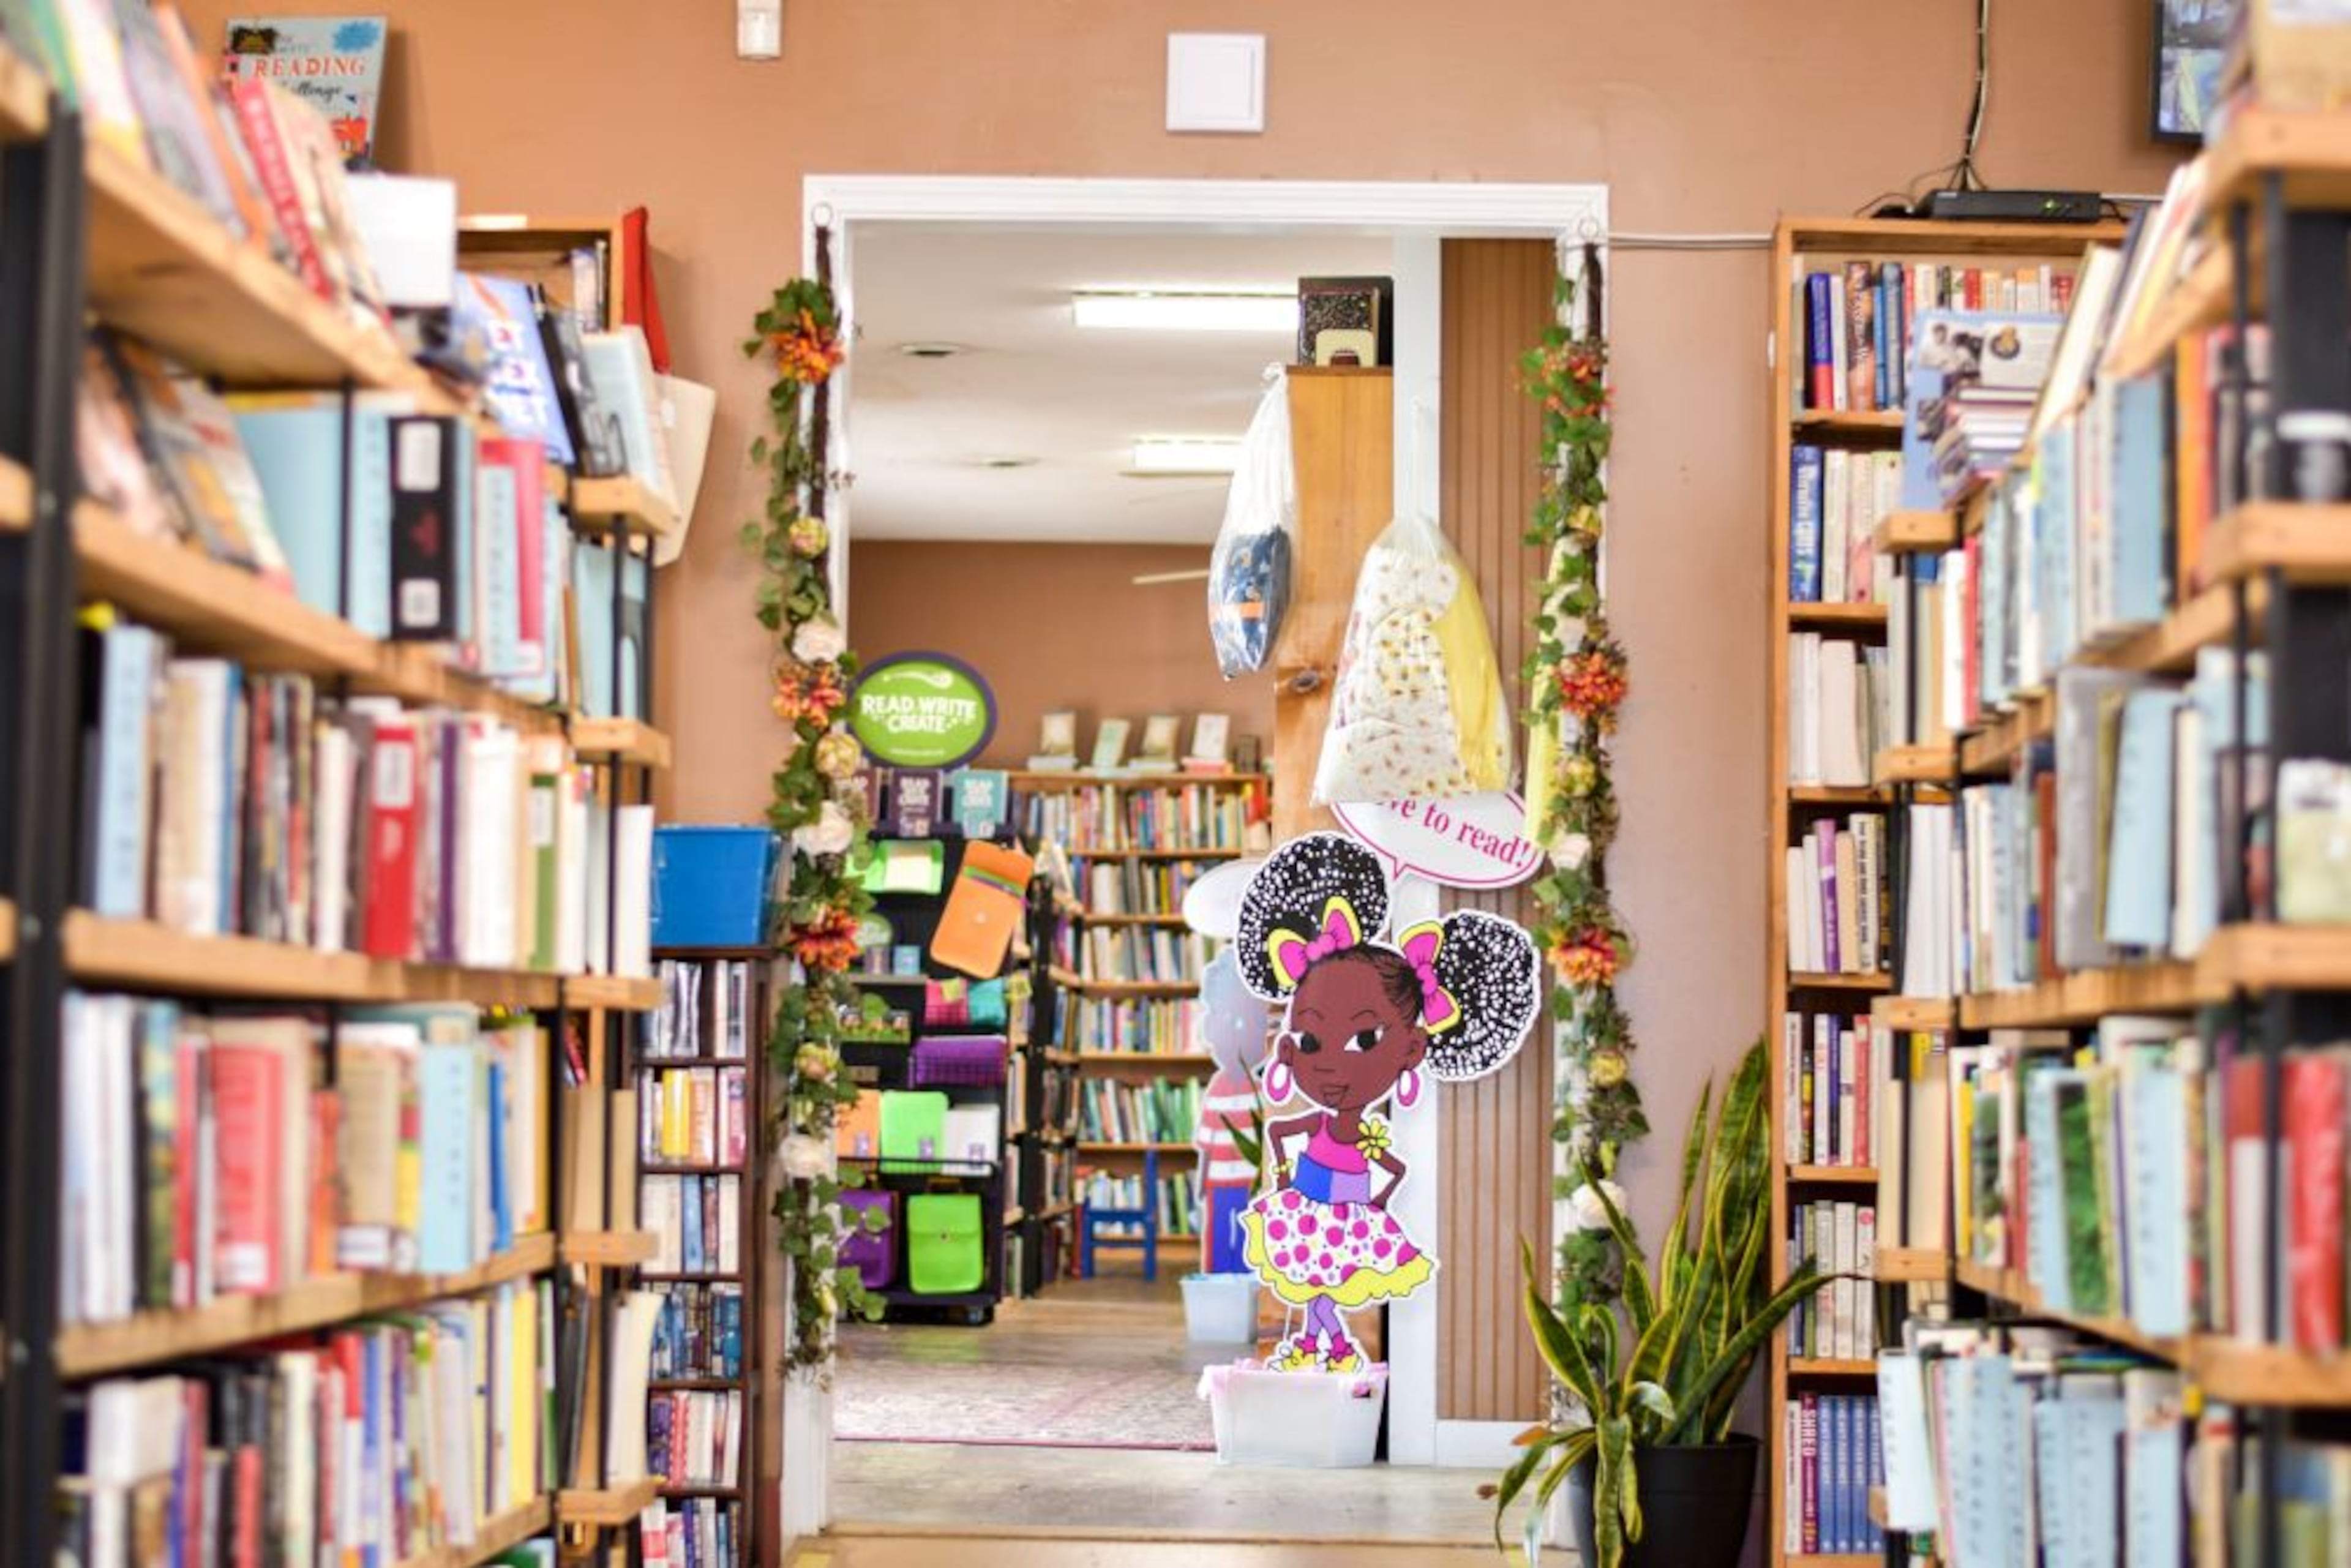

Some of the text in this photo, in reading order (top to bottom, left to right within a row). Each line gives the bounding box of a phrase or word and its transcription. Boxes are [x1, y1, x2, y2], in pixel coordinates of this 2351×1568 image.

[255, 57, 365, 76] READING
[860, 694, 978, 721] READ WRITE
[888, 715, 947, 733] CREATE
[1423, 802, 1449, 833] to
[1457, 822, 1531, 868] read!
[1801, 1409, 1817, 1457] SHRED
